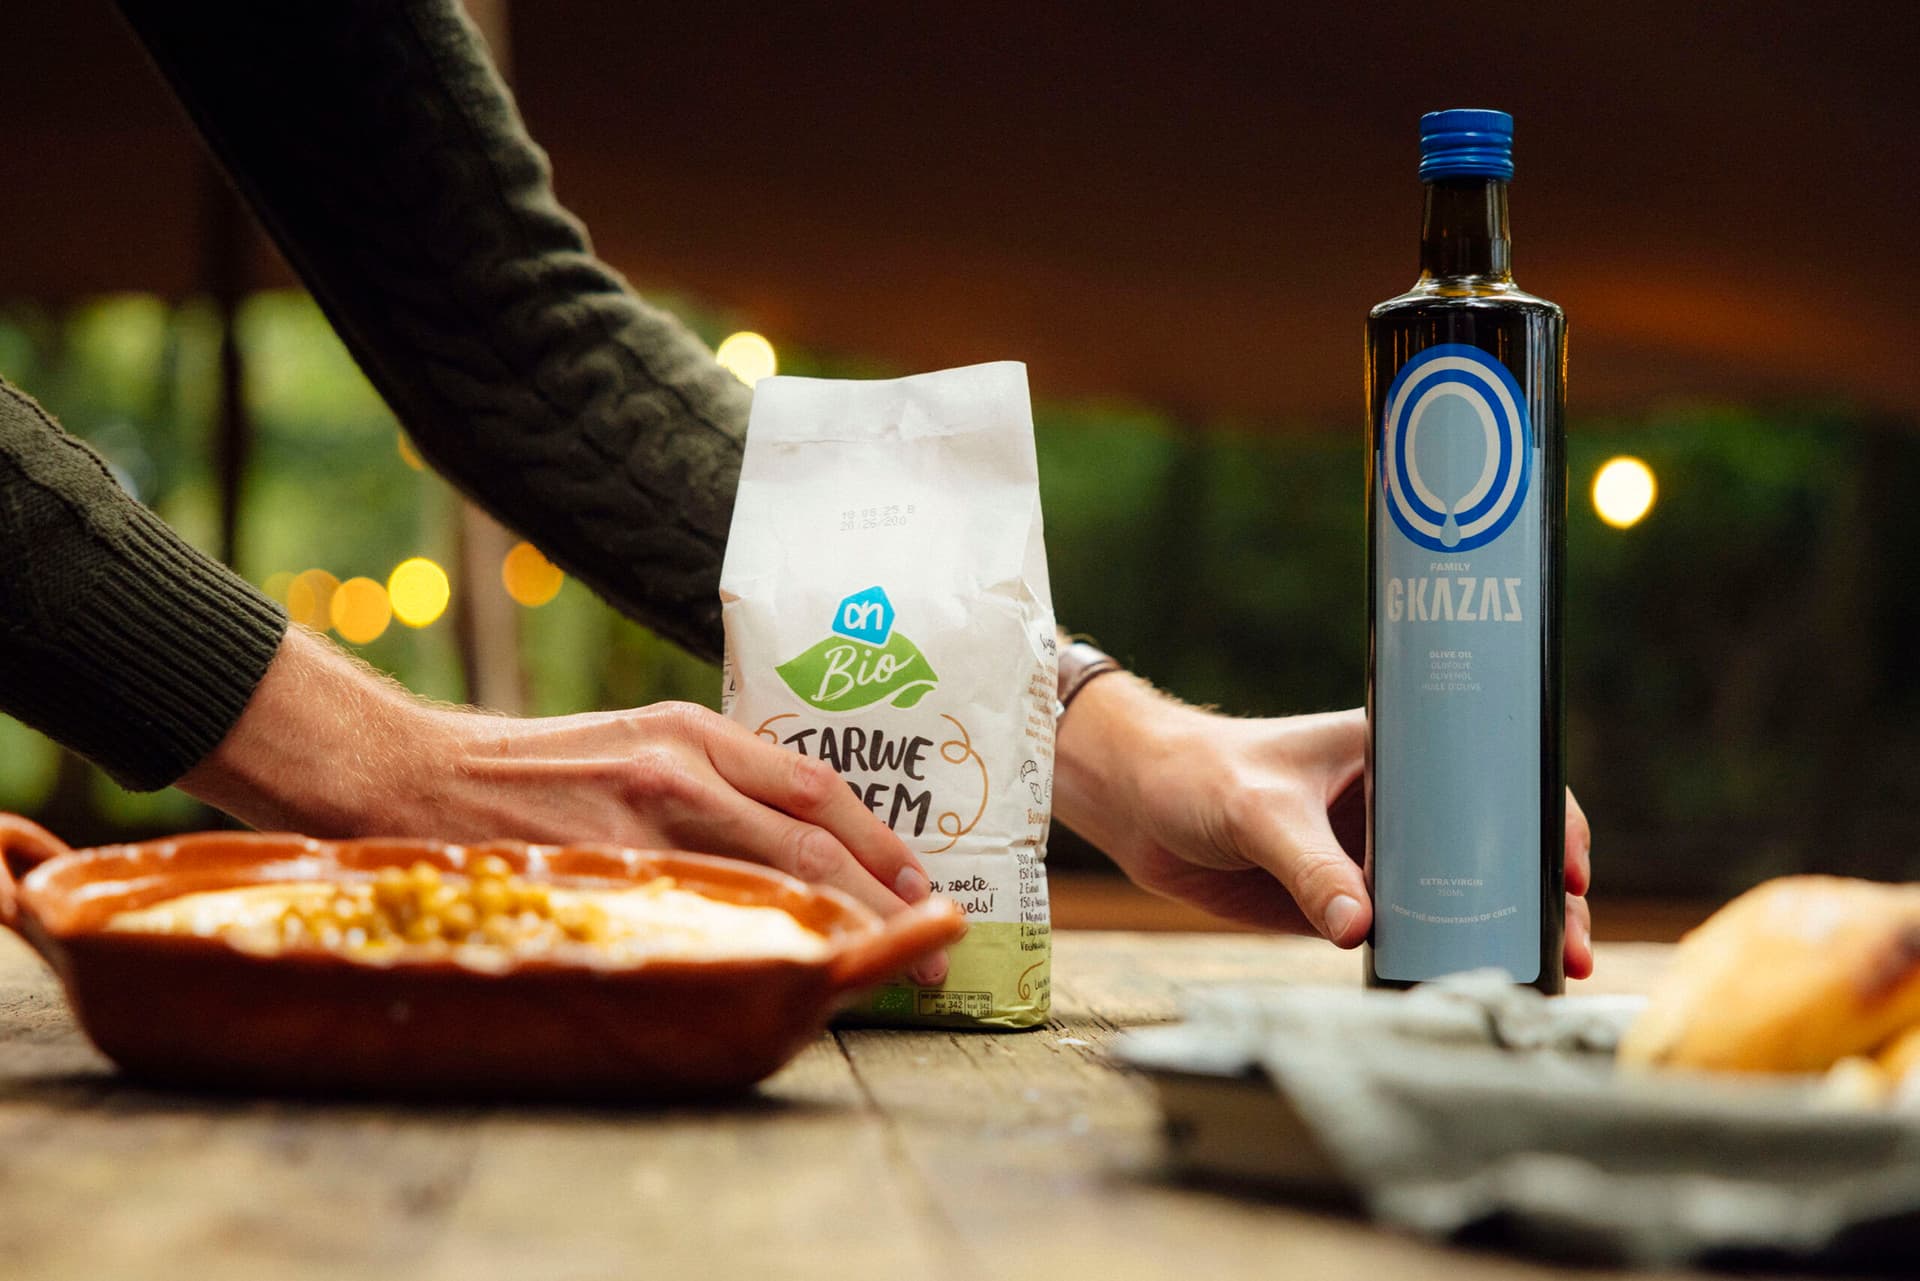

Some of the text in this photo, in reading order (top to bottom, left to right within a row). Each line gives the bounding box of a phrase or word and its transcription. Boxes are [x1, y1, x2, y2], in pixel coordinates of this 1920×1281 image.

[1430, 562, 1471, 572] FAMILY
[1430, 651, 1473, 659] OLIVE OIL
[811, 645, 916, 701] Bio
[783, 727, 934, 781] TARWE
[1420, 878, 1484, 887] EXTRA VIRGIN
[1391, 903, 1518, 924] FROM THE MOUNTAINS OF CRETE
[949, 1000, 963, 1009] 342
